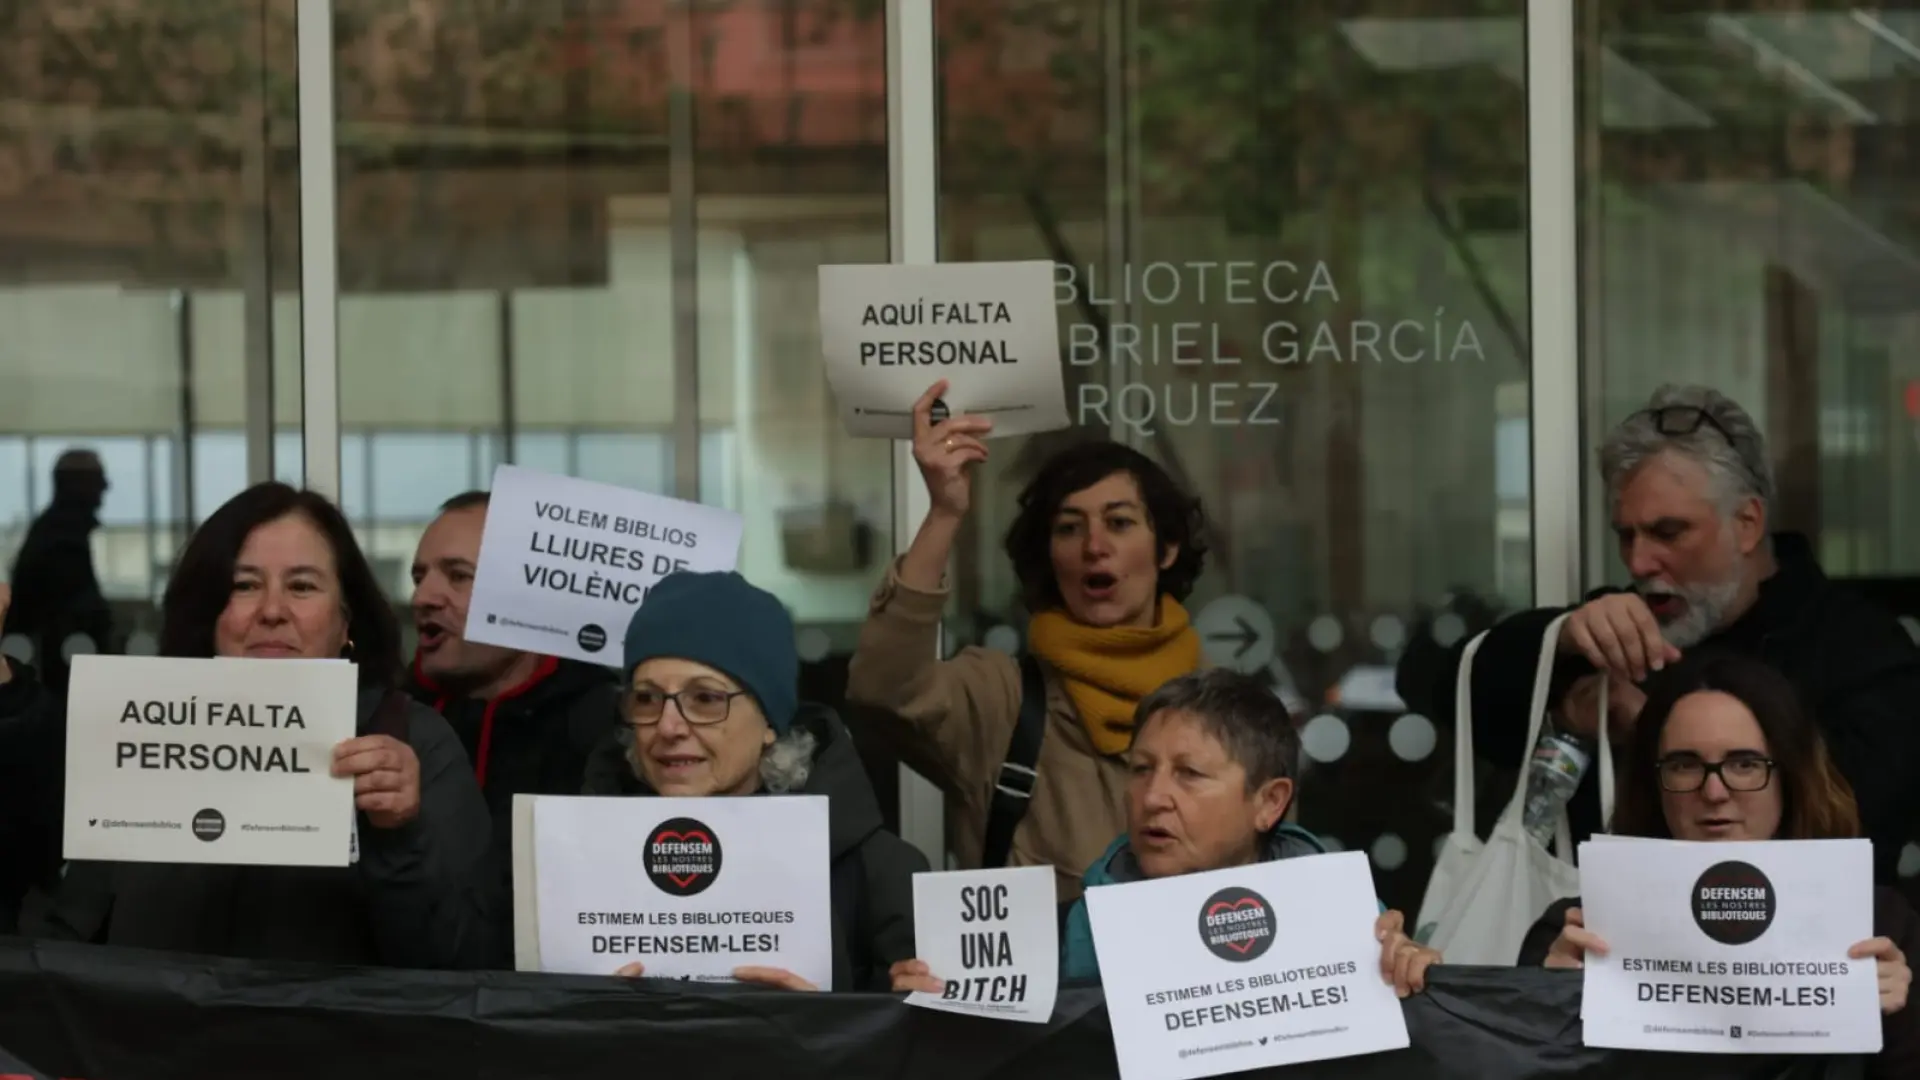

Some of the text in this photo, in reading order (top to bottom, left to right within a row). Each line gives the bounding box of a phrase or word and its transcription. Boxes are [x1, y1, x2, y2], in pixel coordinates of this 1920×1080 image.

[1054, 261, 1340, 304] BLIOTECA
[862, 297, 1011, 326] AQUÍ FALTA
[1069, 305, 1485, 366] BRIEL GARCÍA
[860, 340, 1018, 366] PERSONAL
[1078, 383, 1280, 437] RQUEZ
[534, 501, 698, 549] VOLEM BIBLIOS
[530, 531, 644, 572] LLIURES
[523, 564, 650, 606] VIOLÈNCI
[119, 696, 307, 730] AQUÍ FALTA
[116, 742, 310, 774] PERSONAL
[652, 842, 713, 854] DEFENSEM
[652, 863, 714, 874] BIBLIOTEQUES
[960, 884, 1009, 923] SOC
[1701, 887, 1766, 900] DEFENSEM
[577, 911, 795, 925] ESTIMEM LES BIBLIOTEQUES
[1206, 906, 1267, 927] DEFENSEM
[1701, 910, 1767, 920] BIBLIOTEQUES
[592, 934, 780, 954] DEFENSEM-LES!
[960, 931, 1013, 970] UNA
[1210, 927, 1270, 945] BIBLIOTEQUES
[1622, 958, 1850, 976] ESTIMEM LES BIBLIOTEQUES
[942, 974, 1027, 1003] BITCH
[1145, 961, 1358, 1006] ESTIMEM LES BIBLIOTEQUES
[1637, 983, 1836, 1006] DEFENSEM-LES!
[1165, 985, 1349, 1031] DEFENSEM-LES!
